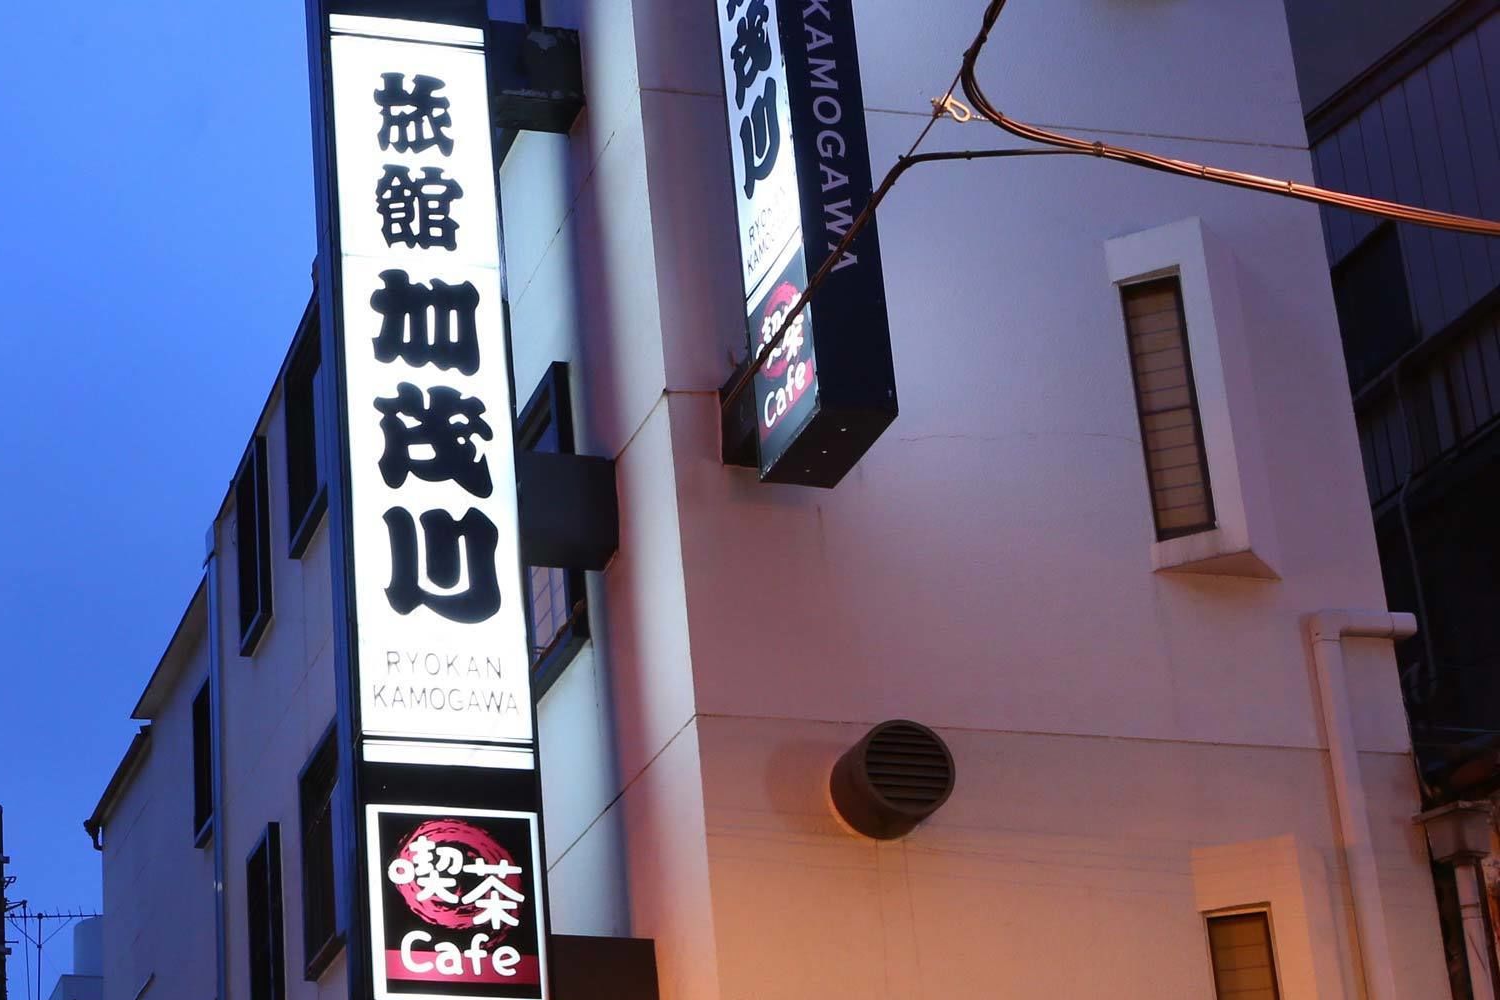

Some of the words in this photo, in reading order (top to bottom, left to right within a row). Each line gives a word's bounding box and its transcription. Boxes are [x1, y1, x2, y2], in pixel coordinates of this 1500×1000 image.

[802, 0, 858, 273] KAMOGAWA
[764, 362, 806, 428] Cafe
[386, 650, 502, 679] RYOKAN
[373, 684, 520, 715] KAMOGAWA
[388, 835, 525, 930] 喫茶
[400, 930, 522, 977] Cafe
